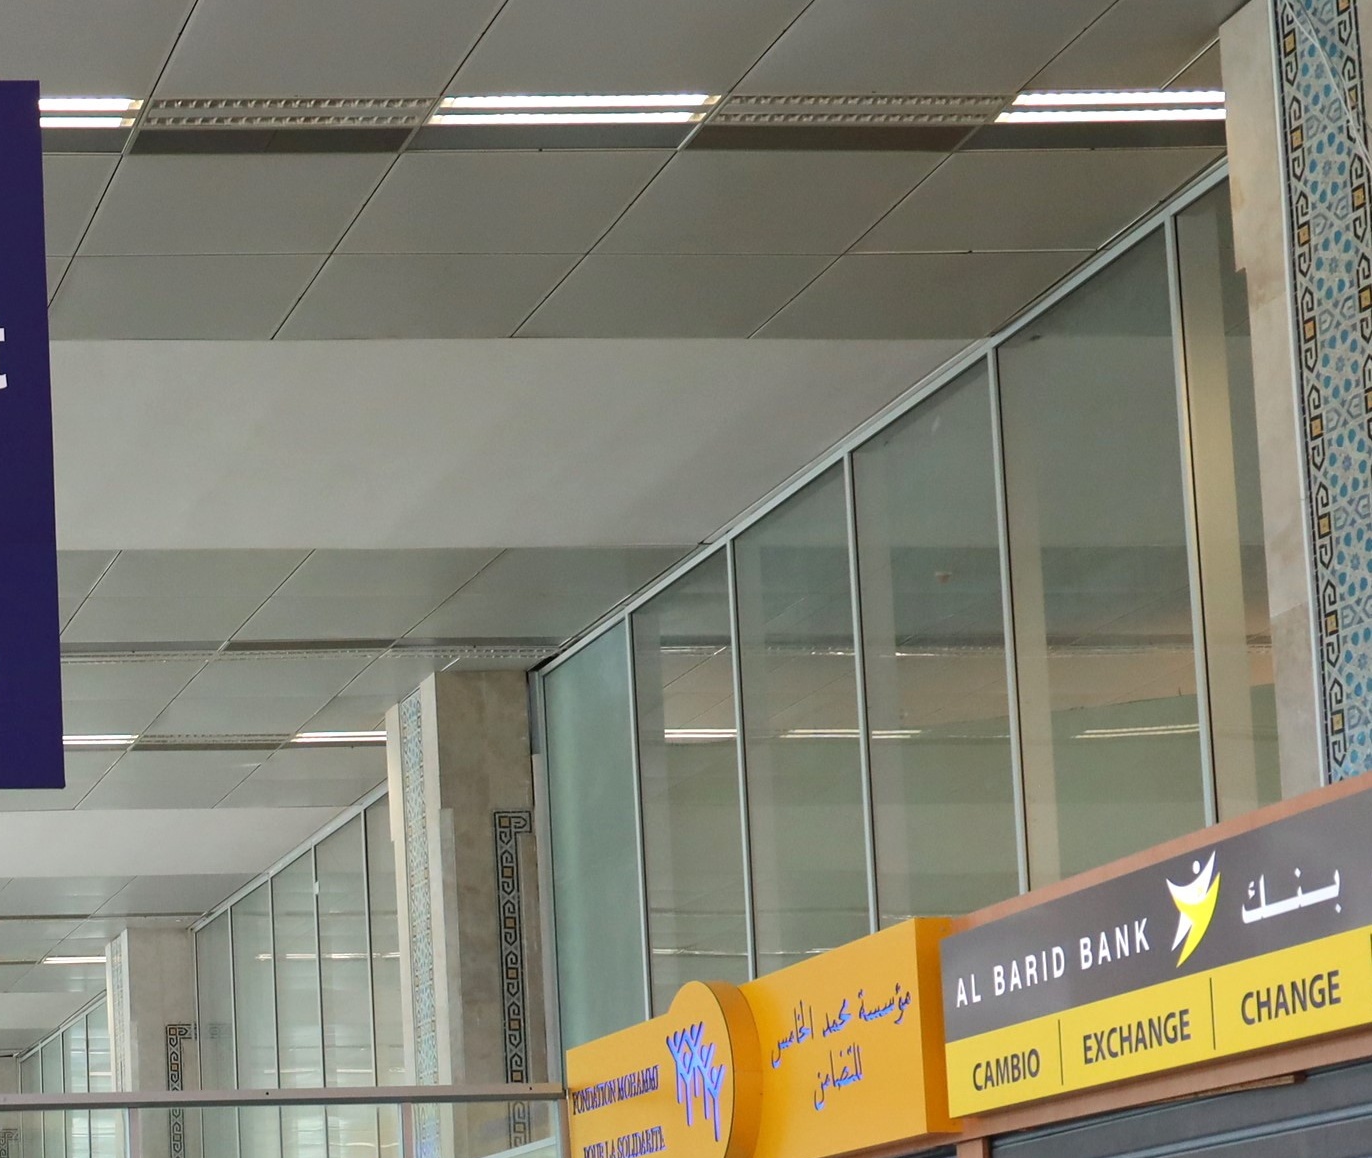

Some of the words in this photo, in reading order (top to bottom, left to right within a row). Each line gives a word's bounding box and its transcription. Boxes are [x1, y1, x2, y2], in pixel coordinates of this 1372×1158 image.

[1241, 868, 1342, 925] بنك
[956, 972, 982, 1009] AL
[992, 945, 1066, 997] BARID
[1079, 917, 1151, 971] BANK
[822, 998, 853, 1038] محمد
[857, 982, 911, 1025] مؤسسة
[1240, 969, 1342, 1026] CHANGE
[771, 999, 814, 1069] الخامس
[1082, 1008, 1192, 1066] EXCHANGE
[572, 1080, 617, 1116] FONDATION
[971, 1048, 1041, 1092] CAMBIO
